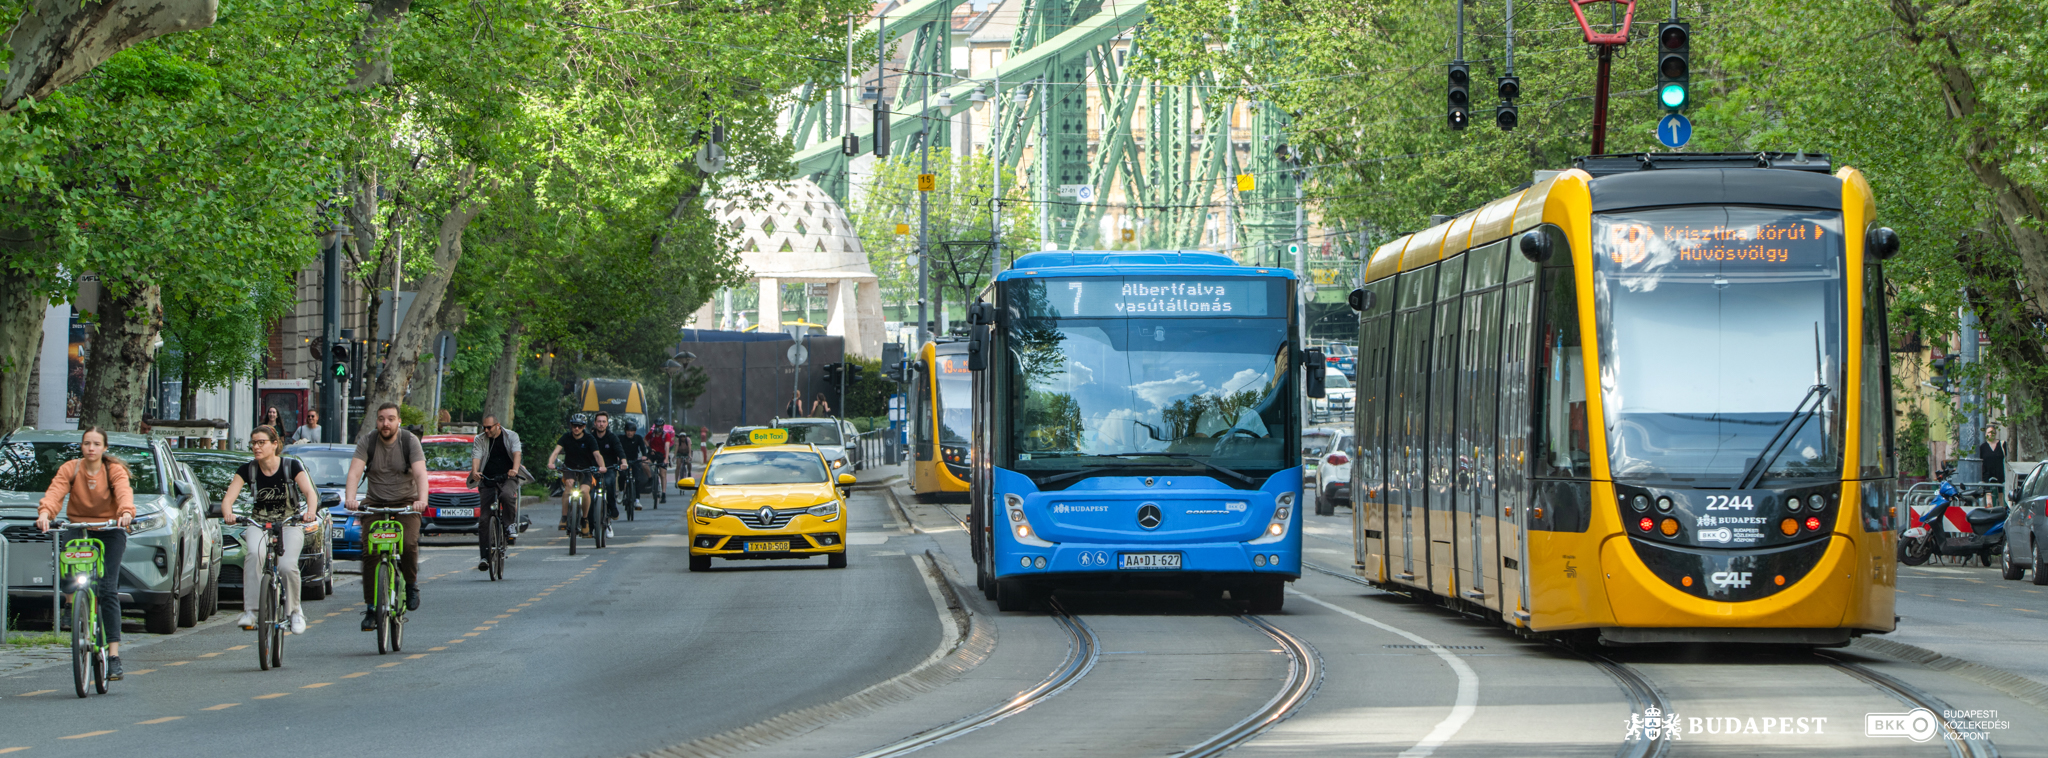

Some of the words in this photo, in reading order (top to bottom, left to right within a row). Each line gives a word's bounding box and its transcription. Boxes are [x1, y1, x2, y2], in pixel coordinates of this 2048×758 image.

[1664, 226, 1748, 240] Krisztina
[1756, 222, 1806, 240] körút
[1680, 244, 1788, 262] Hűvösvölgy
[1068, 282, 1082, 314] 7
[1122, 282, 1226, 296] Albertfalva
[1114, 298, 1232, 312] vasútállomás
[942, 360, 953, 374] 19
[1706, 496, 1754, 510] 2244
[1711, 572, 1752, 588] CAF
